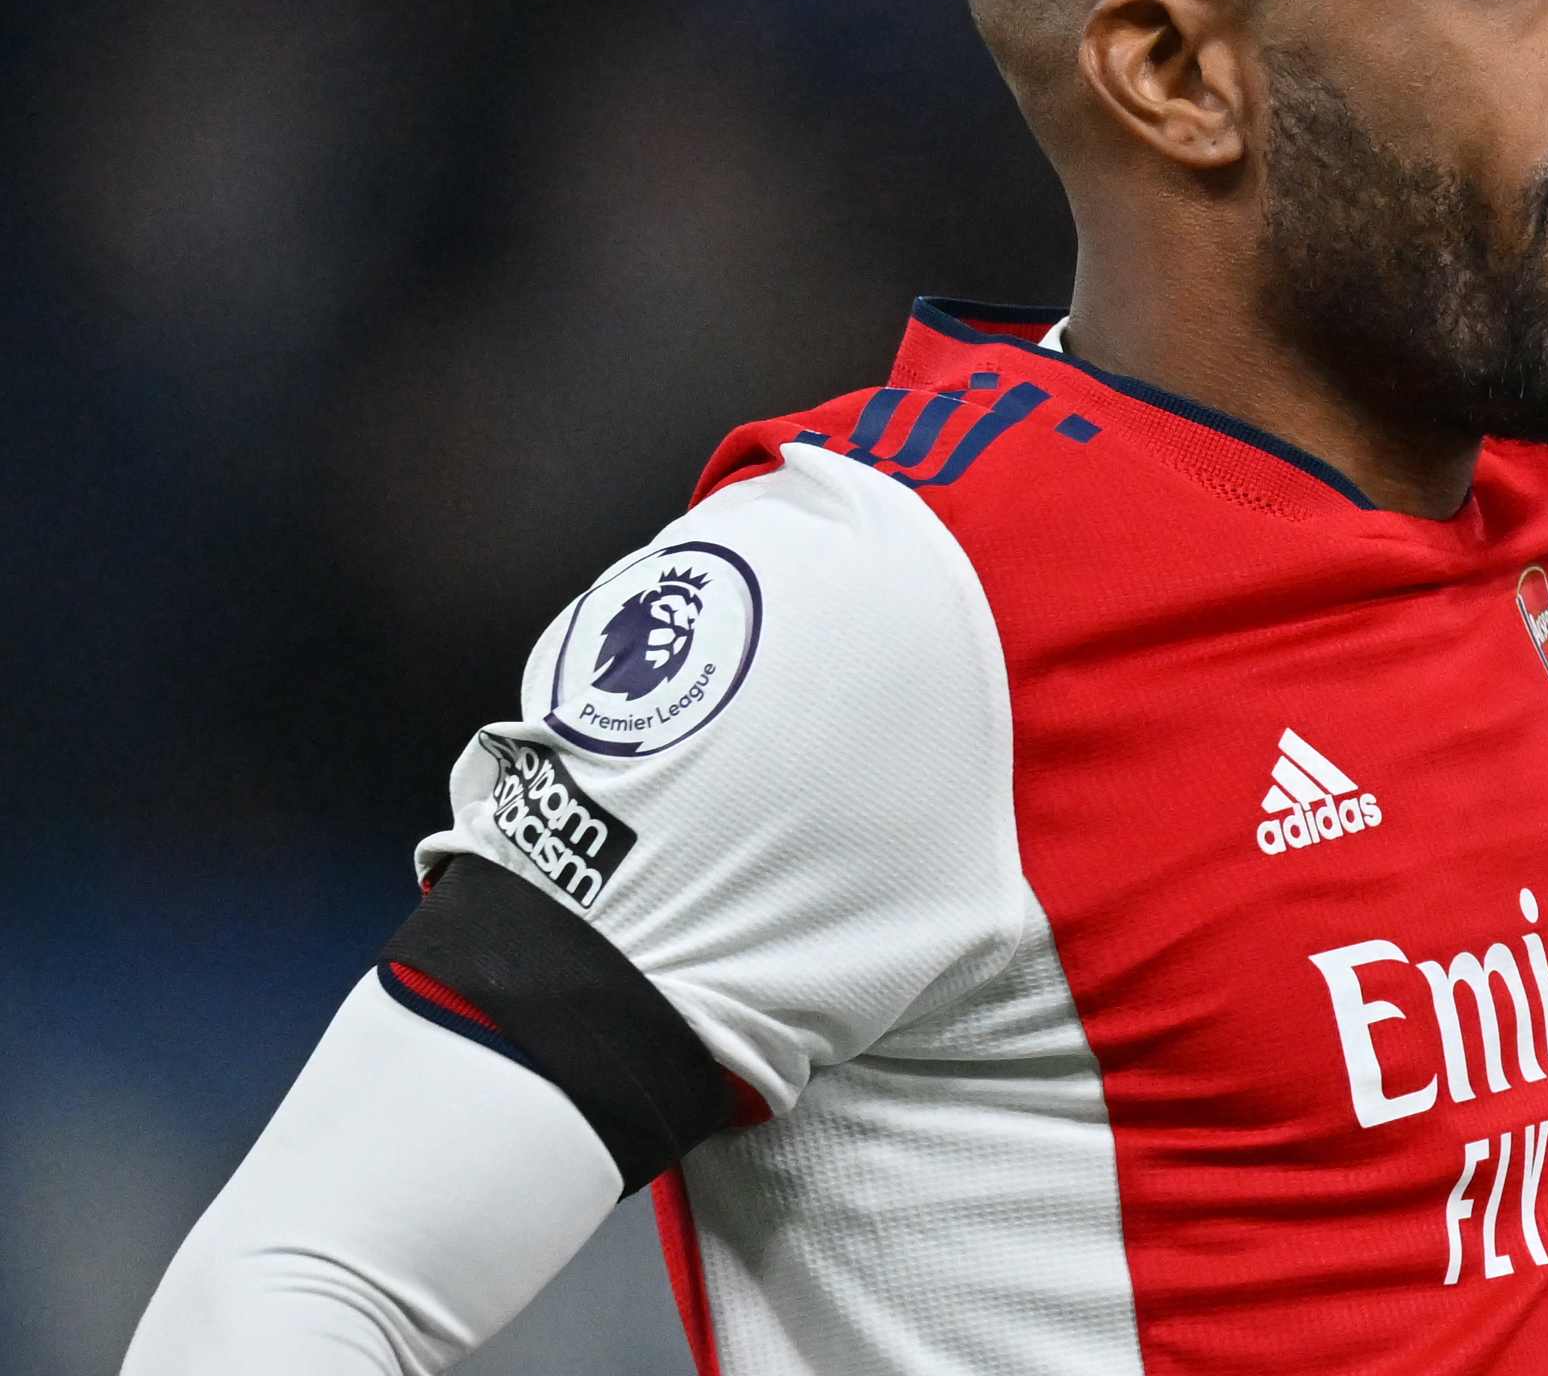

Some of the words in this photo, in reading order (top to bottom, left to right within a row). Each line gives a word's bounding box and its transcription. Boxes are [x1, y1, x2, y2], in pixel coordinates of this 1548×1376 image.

[579, 703, 654, 731] Premier
[656, 662, 717, 723] League
[495, 792, 603, 907] racism
[1256, 793, 1383, 855] adidas
